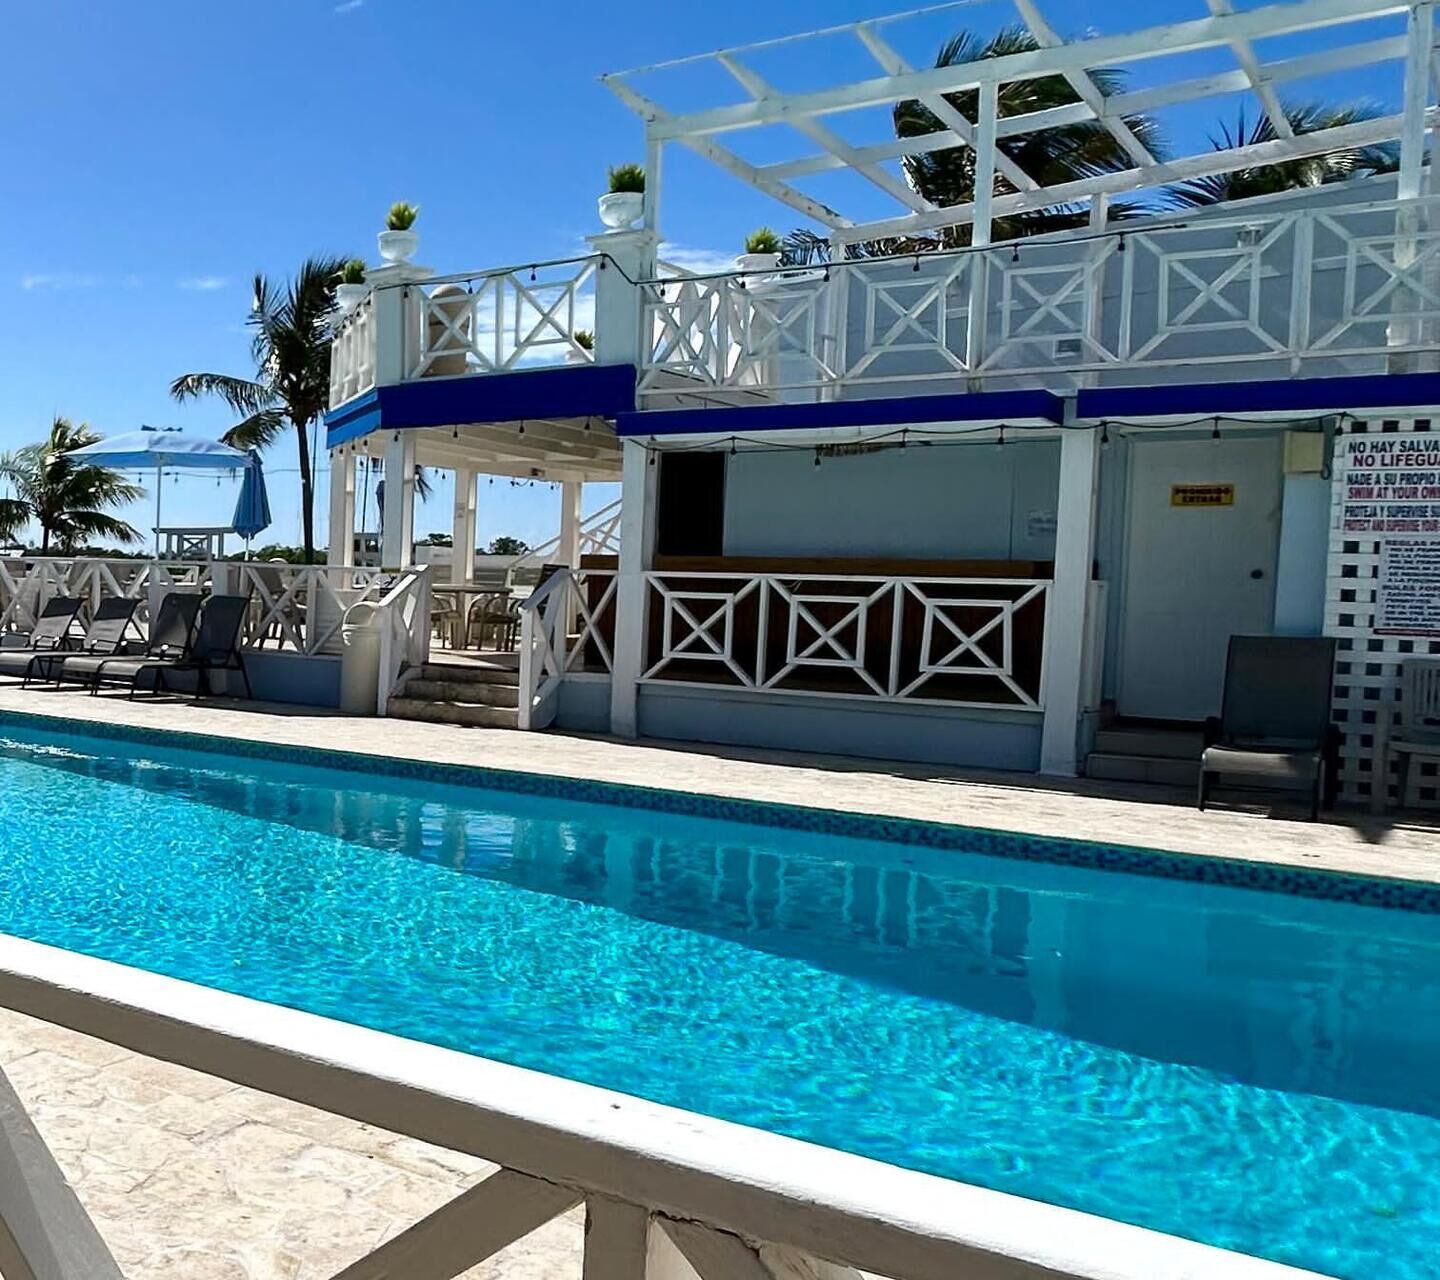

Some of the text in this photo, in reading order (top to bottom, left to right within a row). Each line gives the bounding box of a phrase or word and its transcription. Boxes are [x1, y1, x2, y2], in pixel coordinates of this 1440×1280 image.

[1348, 442, 1366, 453] NO
[1370, 441, 1396, 453] HAY
[1353, 455, 1375, 467] NO
[1347, 473, 1436, 485] NADE A SU PROPIO
[1348, 487, 1373, 499] SWIM
[1376, 487, 1389, 498] AT
[1392, 487, 1419, 498] YOUR
